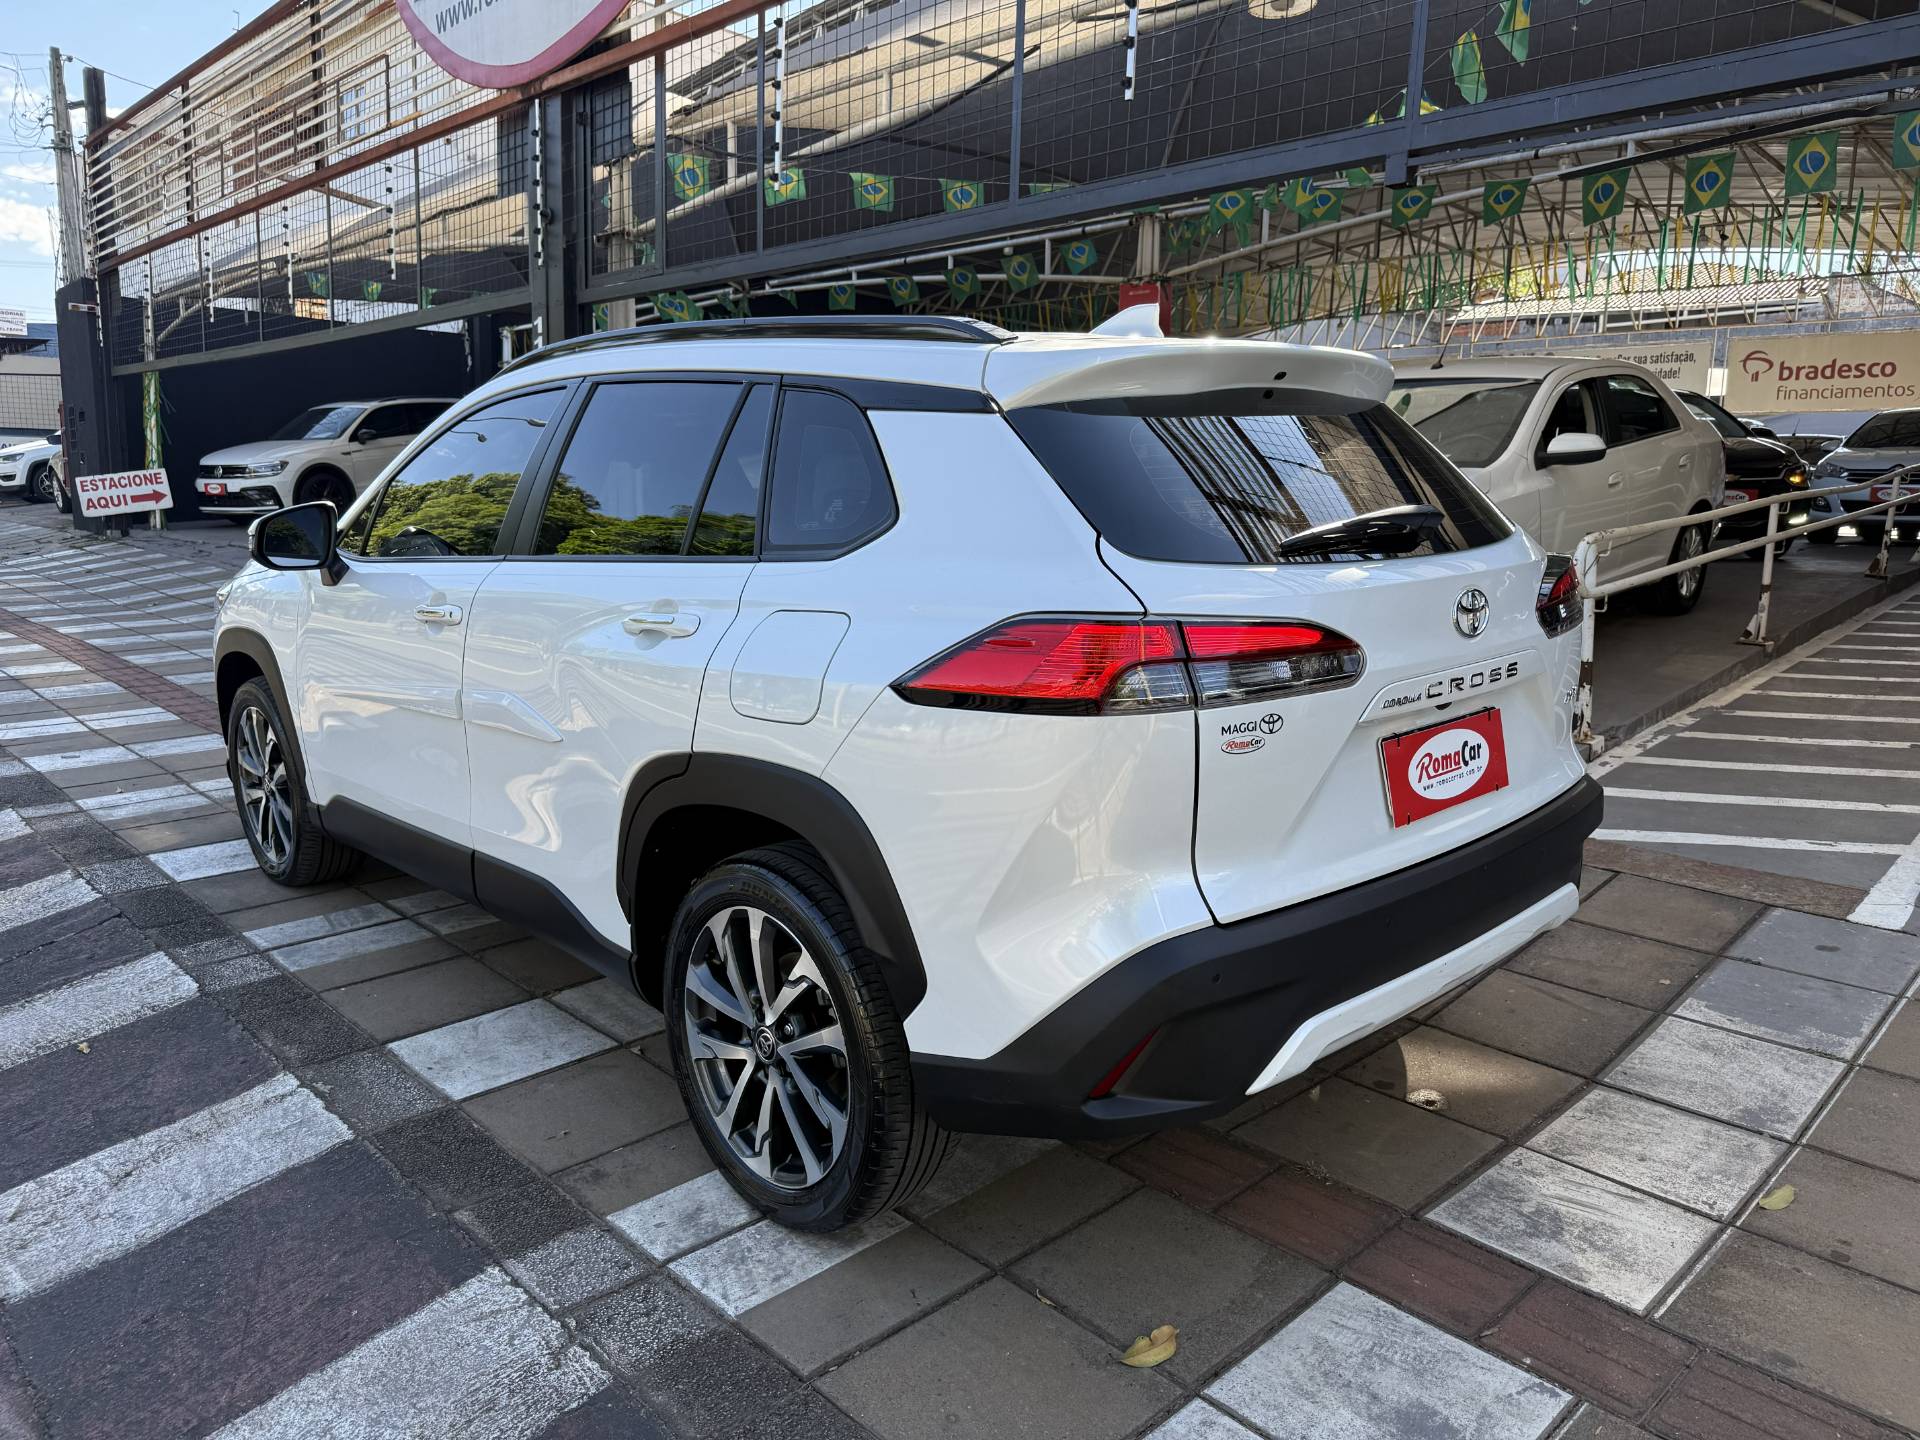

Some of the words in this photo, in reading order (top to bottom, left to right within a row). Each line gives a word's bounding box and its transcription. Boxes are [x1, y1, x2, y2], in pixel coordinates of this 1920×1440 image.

[1633, 354, 1648, 365] sua
[1650, 351, 1696, 365] satisfação,
[1778, 358, 1897, 381] bradesco
[1776, 384, 1915, 400] financiamentos
[80, 472, 164, 492] ESTACIONE
[86, 494, 128, 511] AQUI
[1382, 692, 1422, 709] COROLLA
[1425, 661, 1518, 698] CROSS
[1221, 720, 1257, 736] MAGGI
[1225, 738, 1263, 750] RomaCar
[1416, 740, 1482, 784] RomaCar
